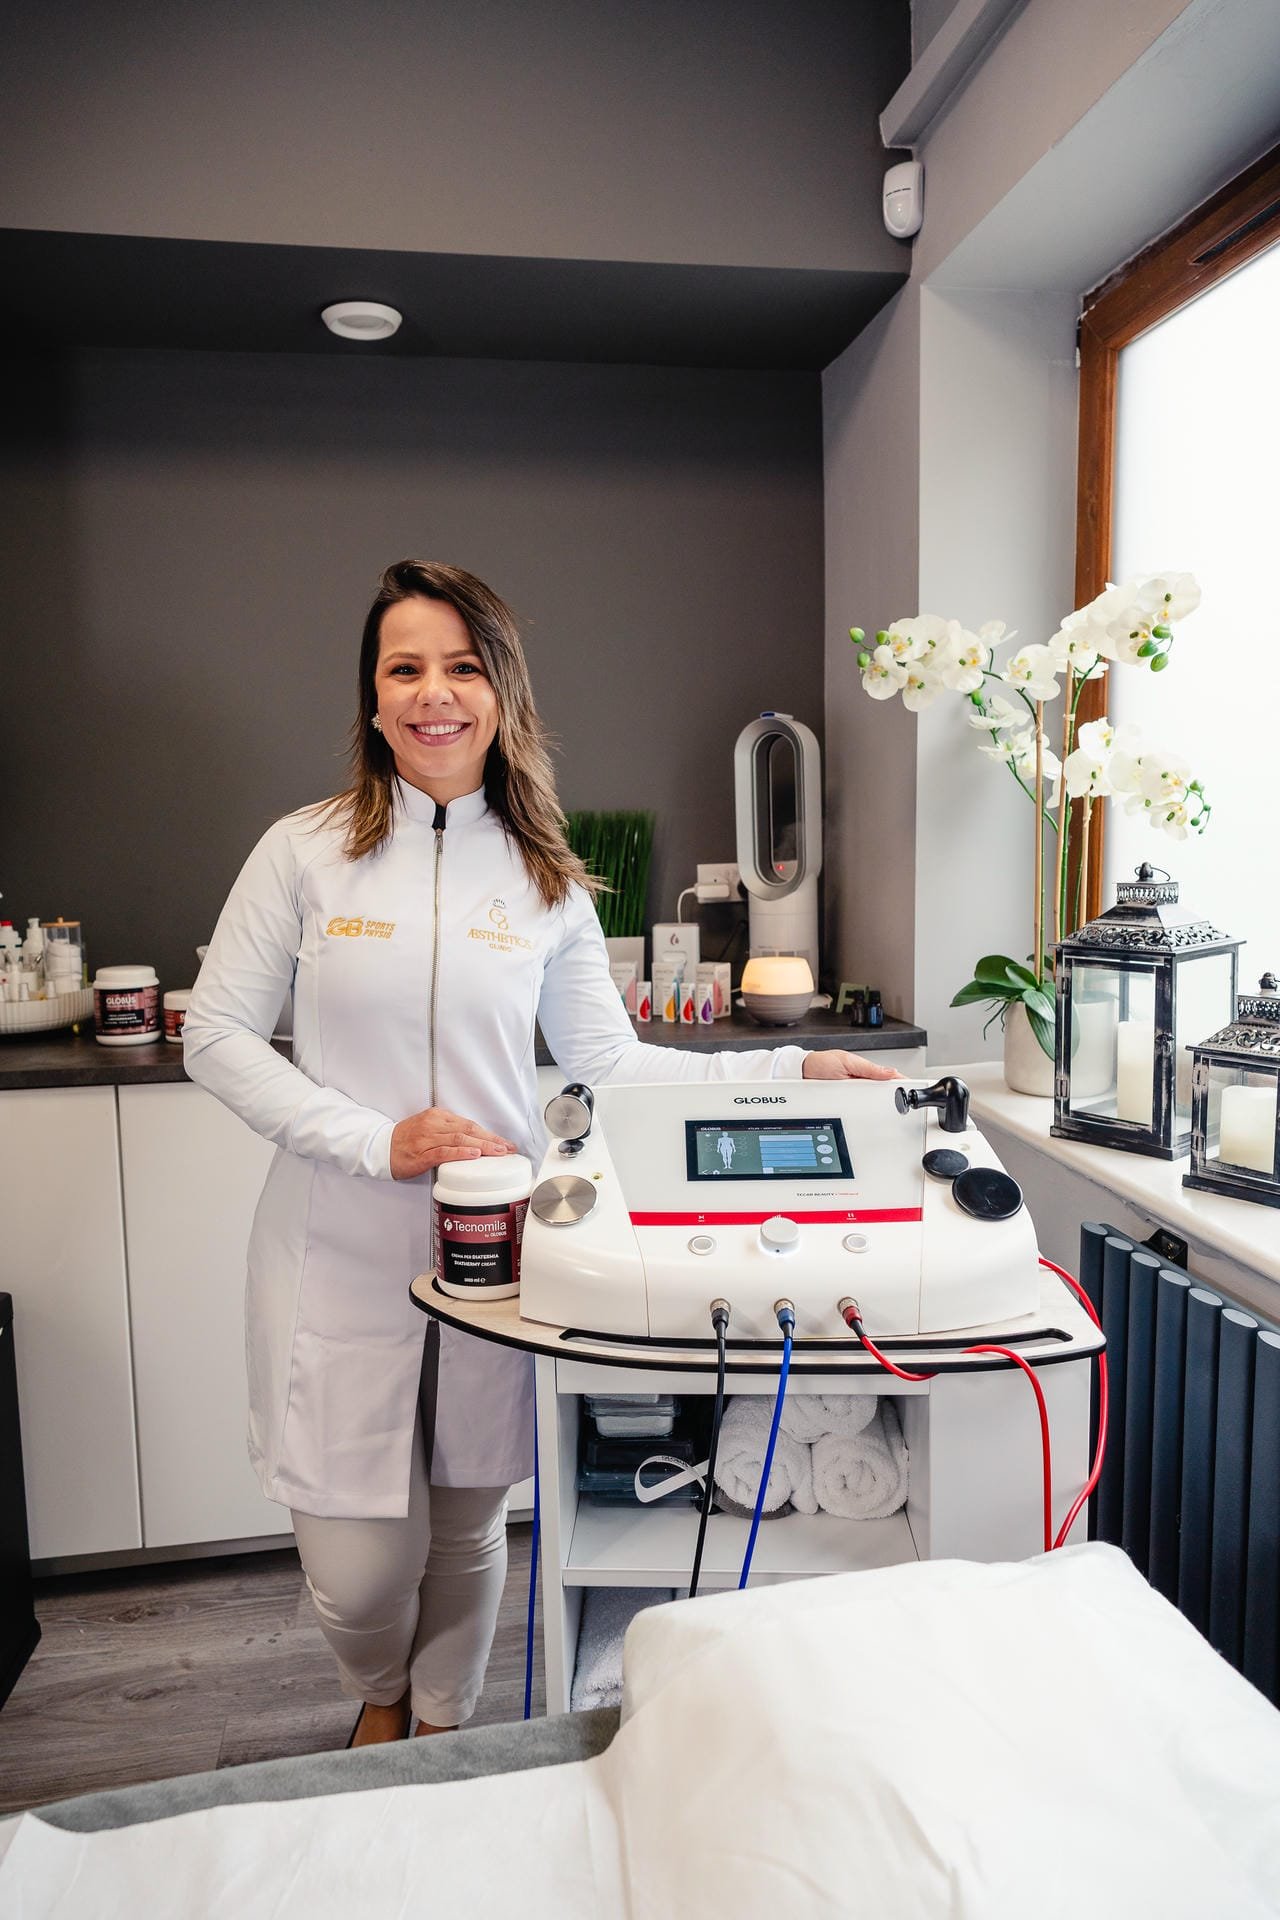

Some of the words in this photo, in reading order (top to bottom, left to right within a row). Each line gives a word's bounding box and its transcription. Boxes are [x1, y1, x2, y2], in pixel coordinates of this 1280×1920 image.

[366, 920, 395, 931] SPORTS
[106, 997, 137, 1005] GLOBUS
[733, 1096, 787, 1104] GLOBUS
[453, 1220, 507, 1233] Tecnomila
